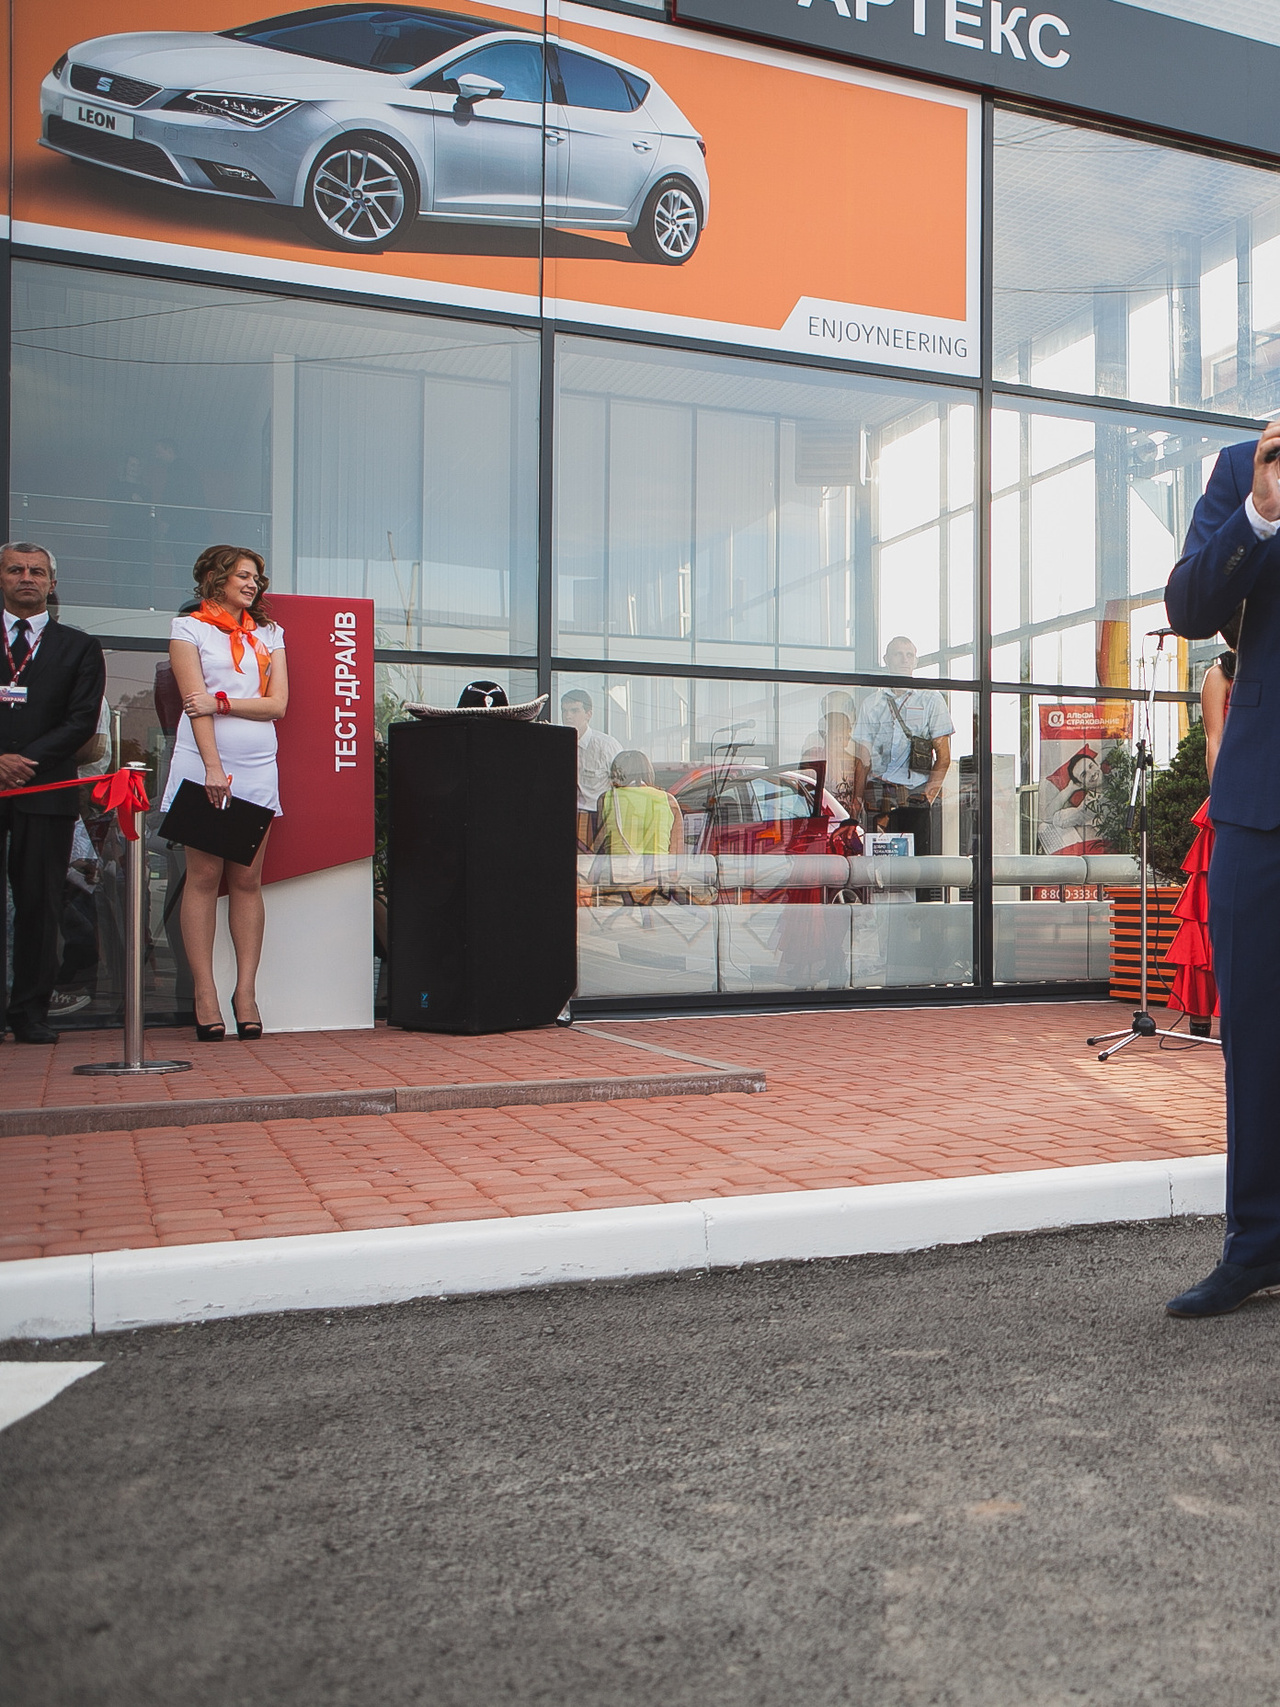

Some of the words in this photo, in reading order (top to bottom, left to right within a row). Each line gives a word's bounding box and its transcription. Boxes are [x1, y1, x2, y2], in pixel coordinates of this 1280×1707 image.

[78, 107, 116, 131] LEON
[808, 316, 968, 358] ENJOYNEERING
[329, 611, 361, 773] ТЕСТ-ДРАЙВ
[1066, 718, 1120, 726] СТРАХОВАНИЕ
